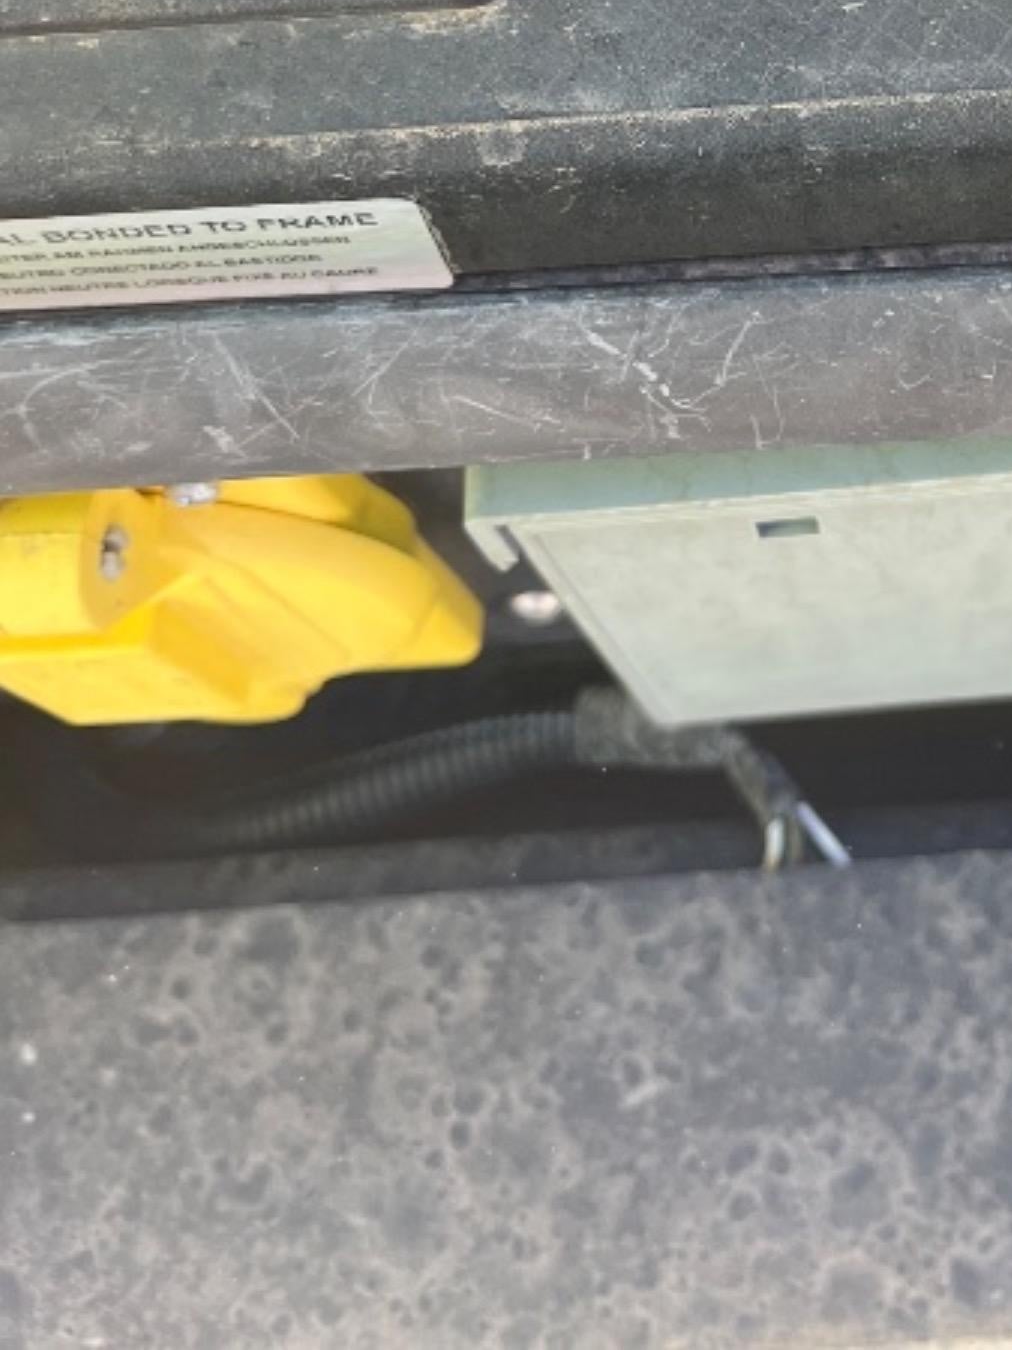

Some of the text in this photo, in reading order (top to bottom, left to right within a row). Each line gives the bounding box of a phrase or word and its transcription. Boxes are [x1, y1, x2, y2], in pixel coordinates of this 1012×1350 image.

[42, 223, 193, 244] BONDED
[198, 220, 247, 233] TO
[256, 211, 379, 230] FRAME
